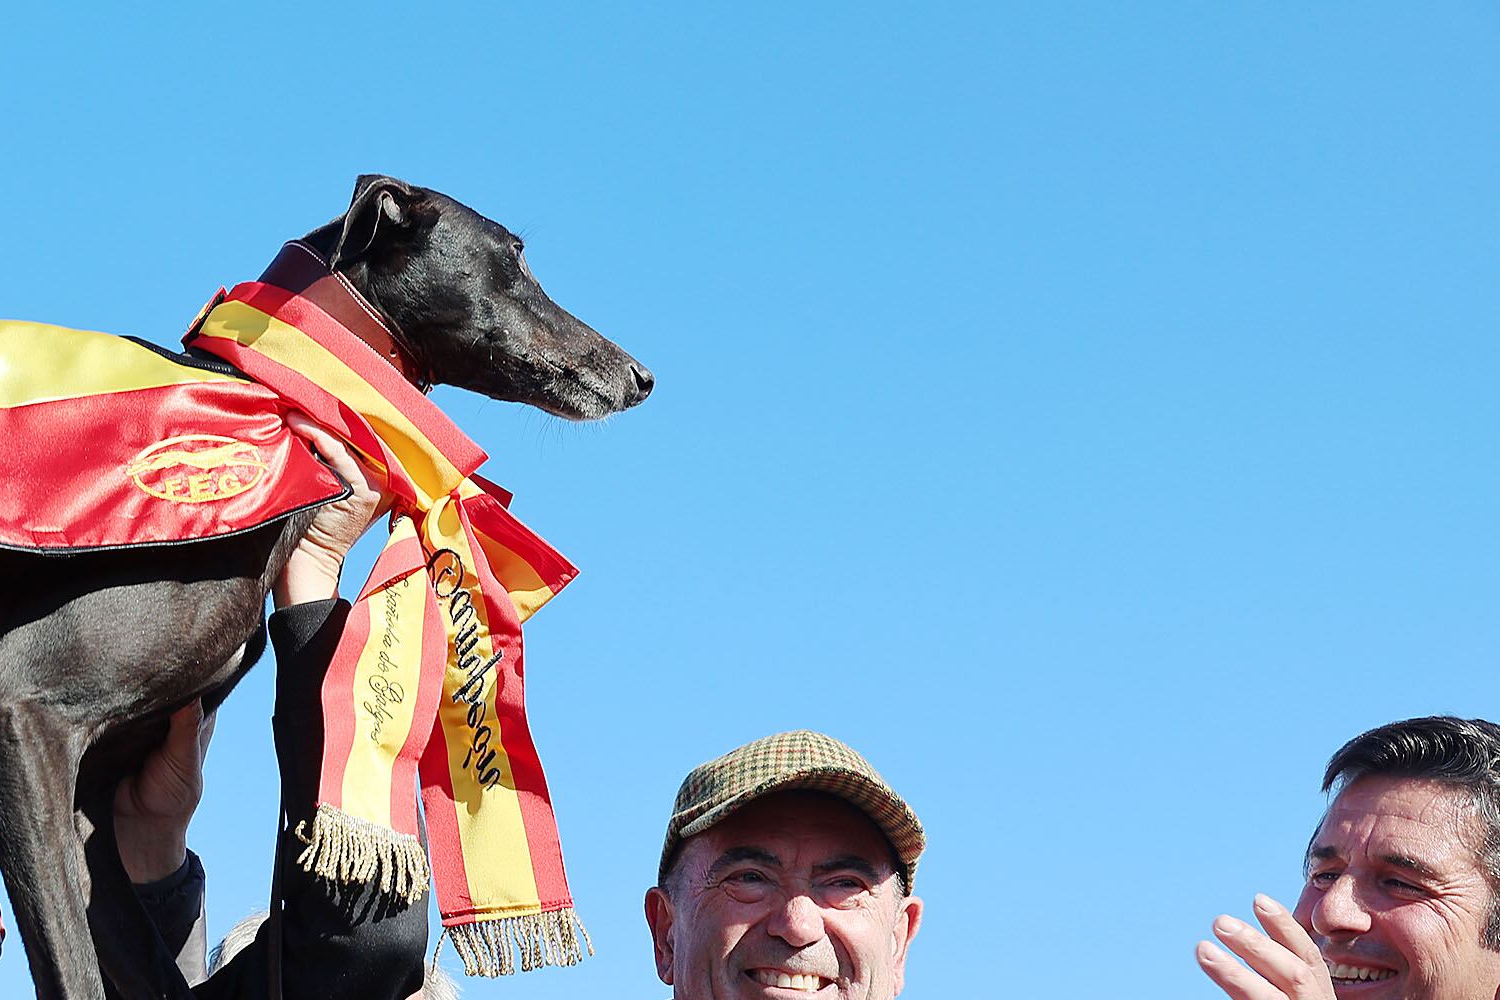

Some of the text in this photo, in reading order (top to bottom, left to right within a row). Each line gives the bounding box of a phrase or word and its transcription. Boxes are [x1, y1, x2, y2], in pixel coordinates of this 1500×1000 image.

[164, 471, 242, 501] FEG
[377, 650, 399, 673] de
[363, 674, 405, 745] Galgos
